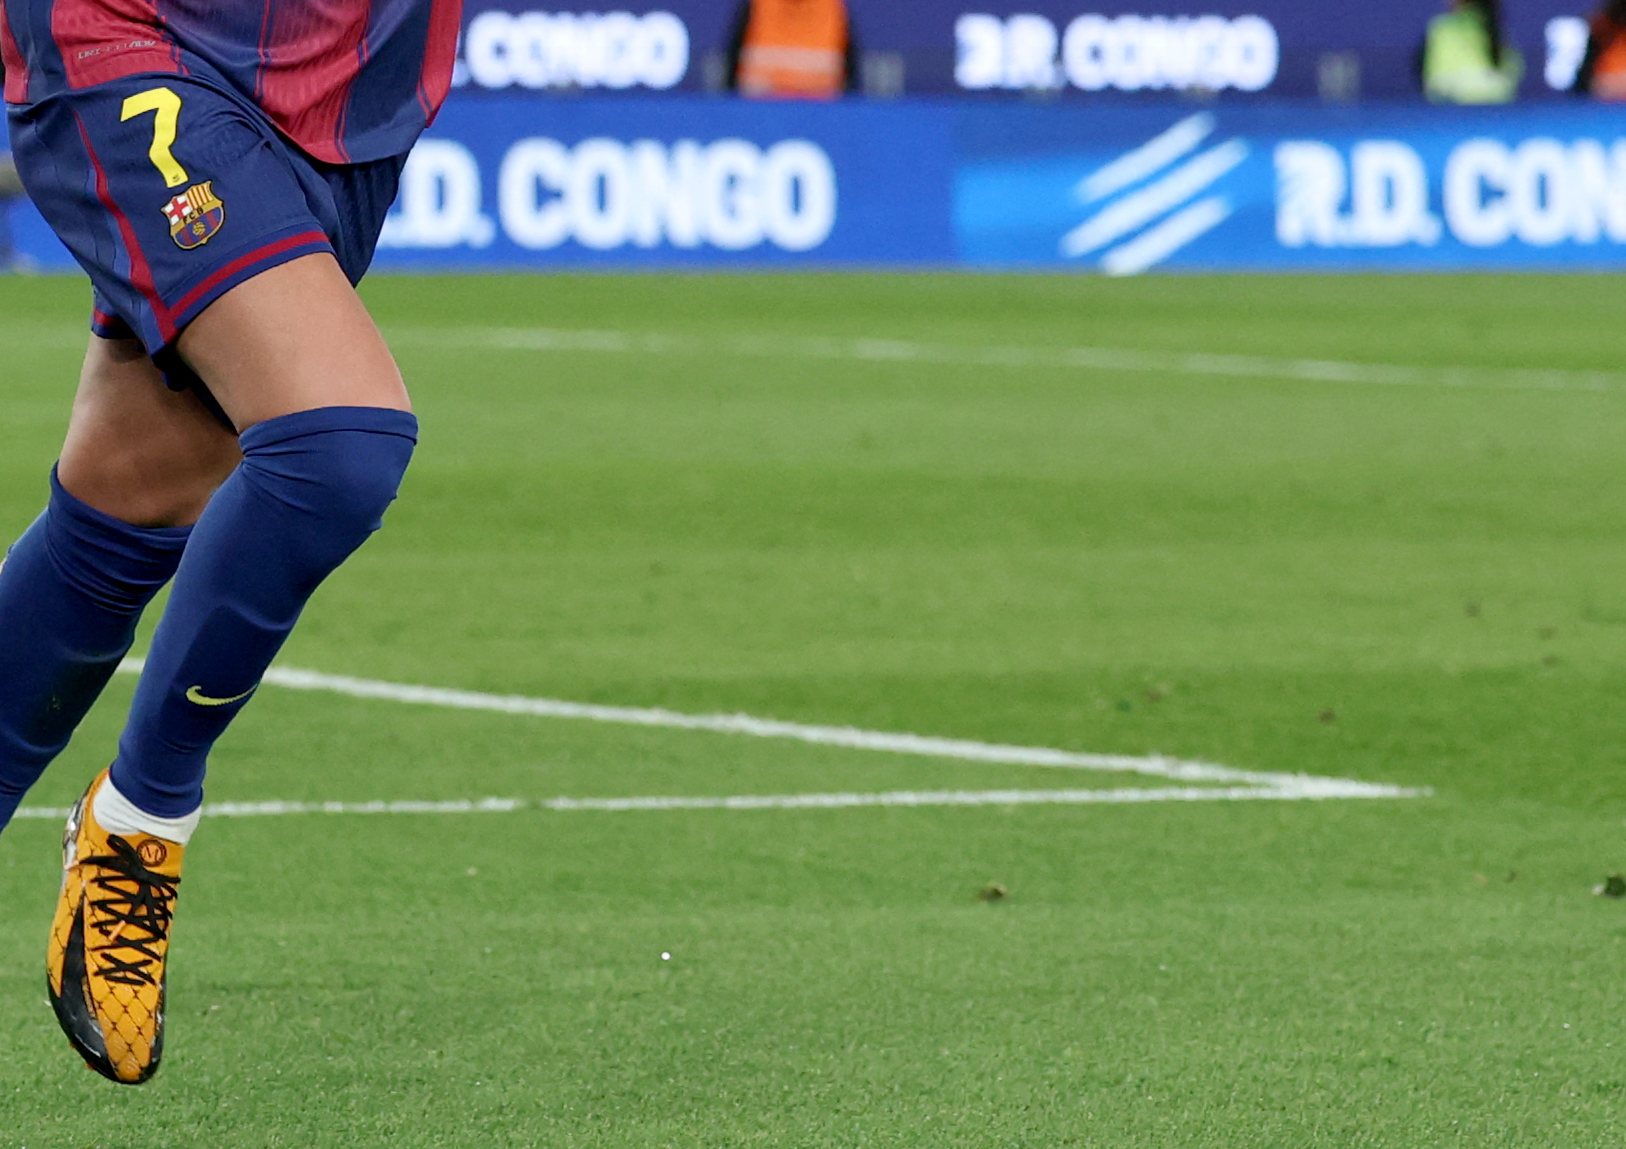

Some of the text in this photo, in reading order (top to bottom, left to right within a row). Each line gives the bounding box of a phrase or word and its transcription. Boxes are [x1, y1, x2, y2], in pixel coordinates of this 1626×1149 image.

[120, 86, 190, 189] 7
[498, 136, 837, 251] CONGO
[1276, 140, 1442, 247] R.D.
